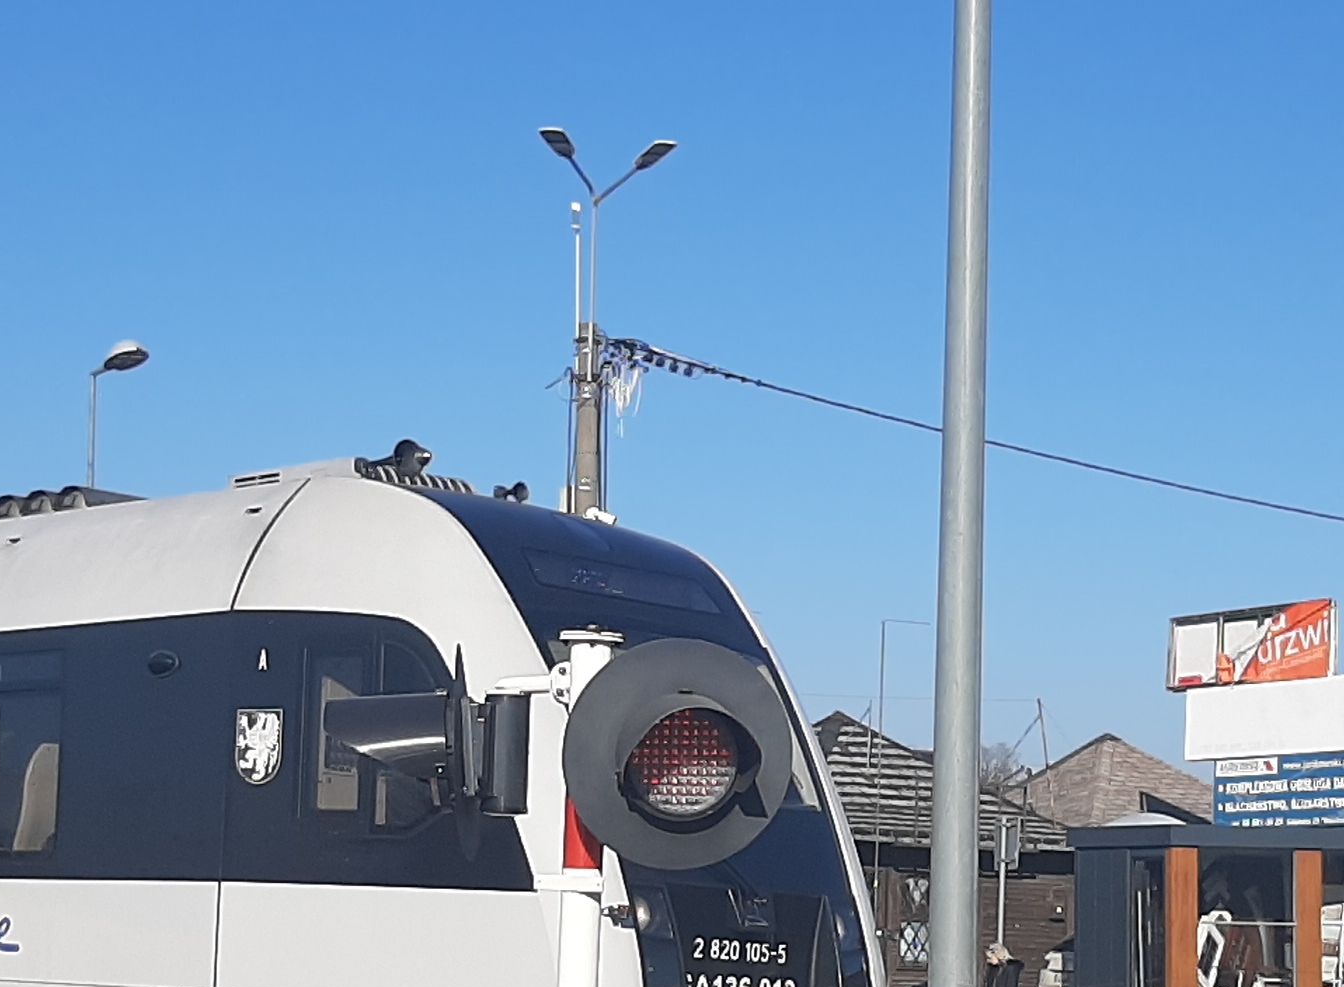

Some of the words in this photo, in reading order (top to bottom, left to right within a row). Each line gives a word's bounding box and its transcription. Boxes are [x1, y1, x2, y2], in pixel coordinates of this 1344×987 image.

[258, 648, 267, 670] A
[693, 937, 704, 959] 2
[710, 939, 740, 961] 820
[745, 941, 787, 964] 105-5
